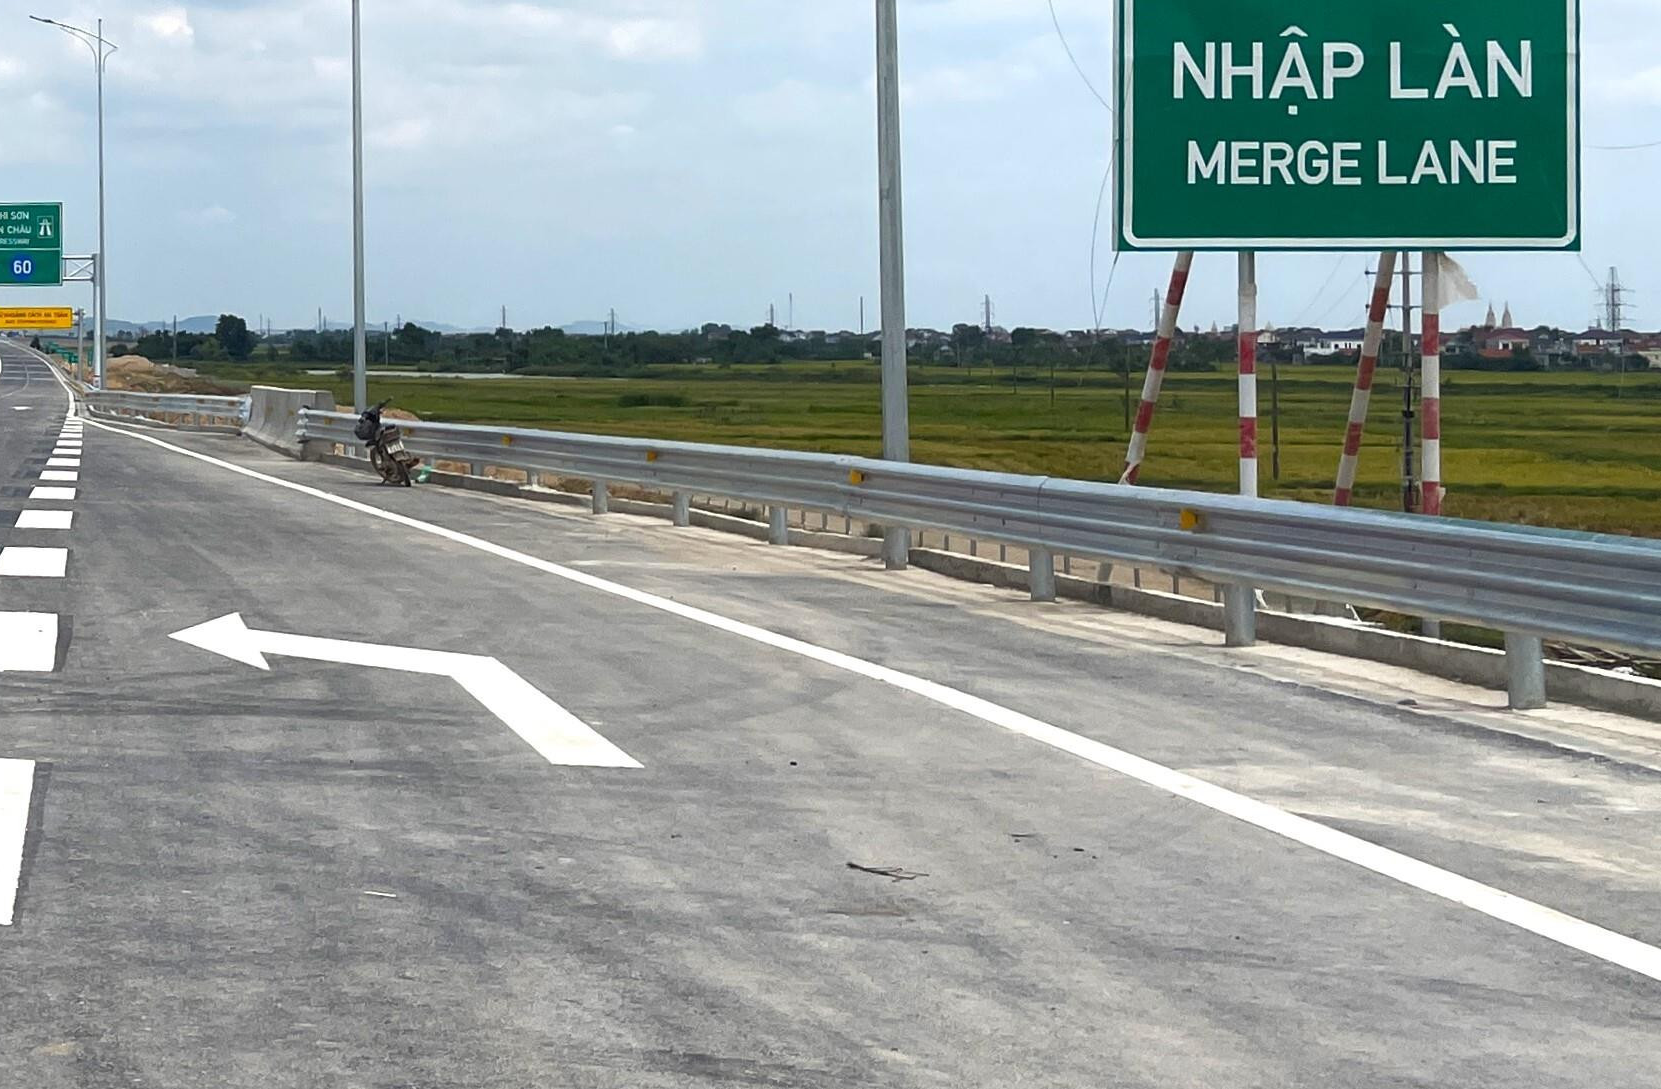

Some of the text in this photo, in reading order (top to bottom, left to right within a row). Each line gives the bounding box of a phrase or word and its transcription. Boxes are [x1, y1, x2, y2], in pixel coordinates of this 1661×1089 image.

[1172, 23, 1533, 116] NHẬP LÀN
[1187, 139, 1518, 186] MERGE LANE
[13, 260, 32, 274] 60
